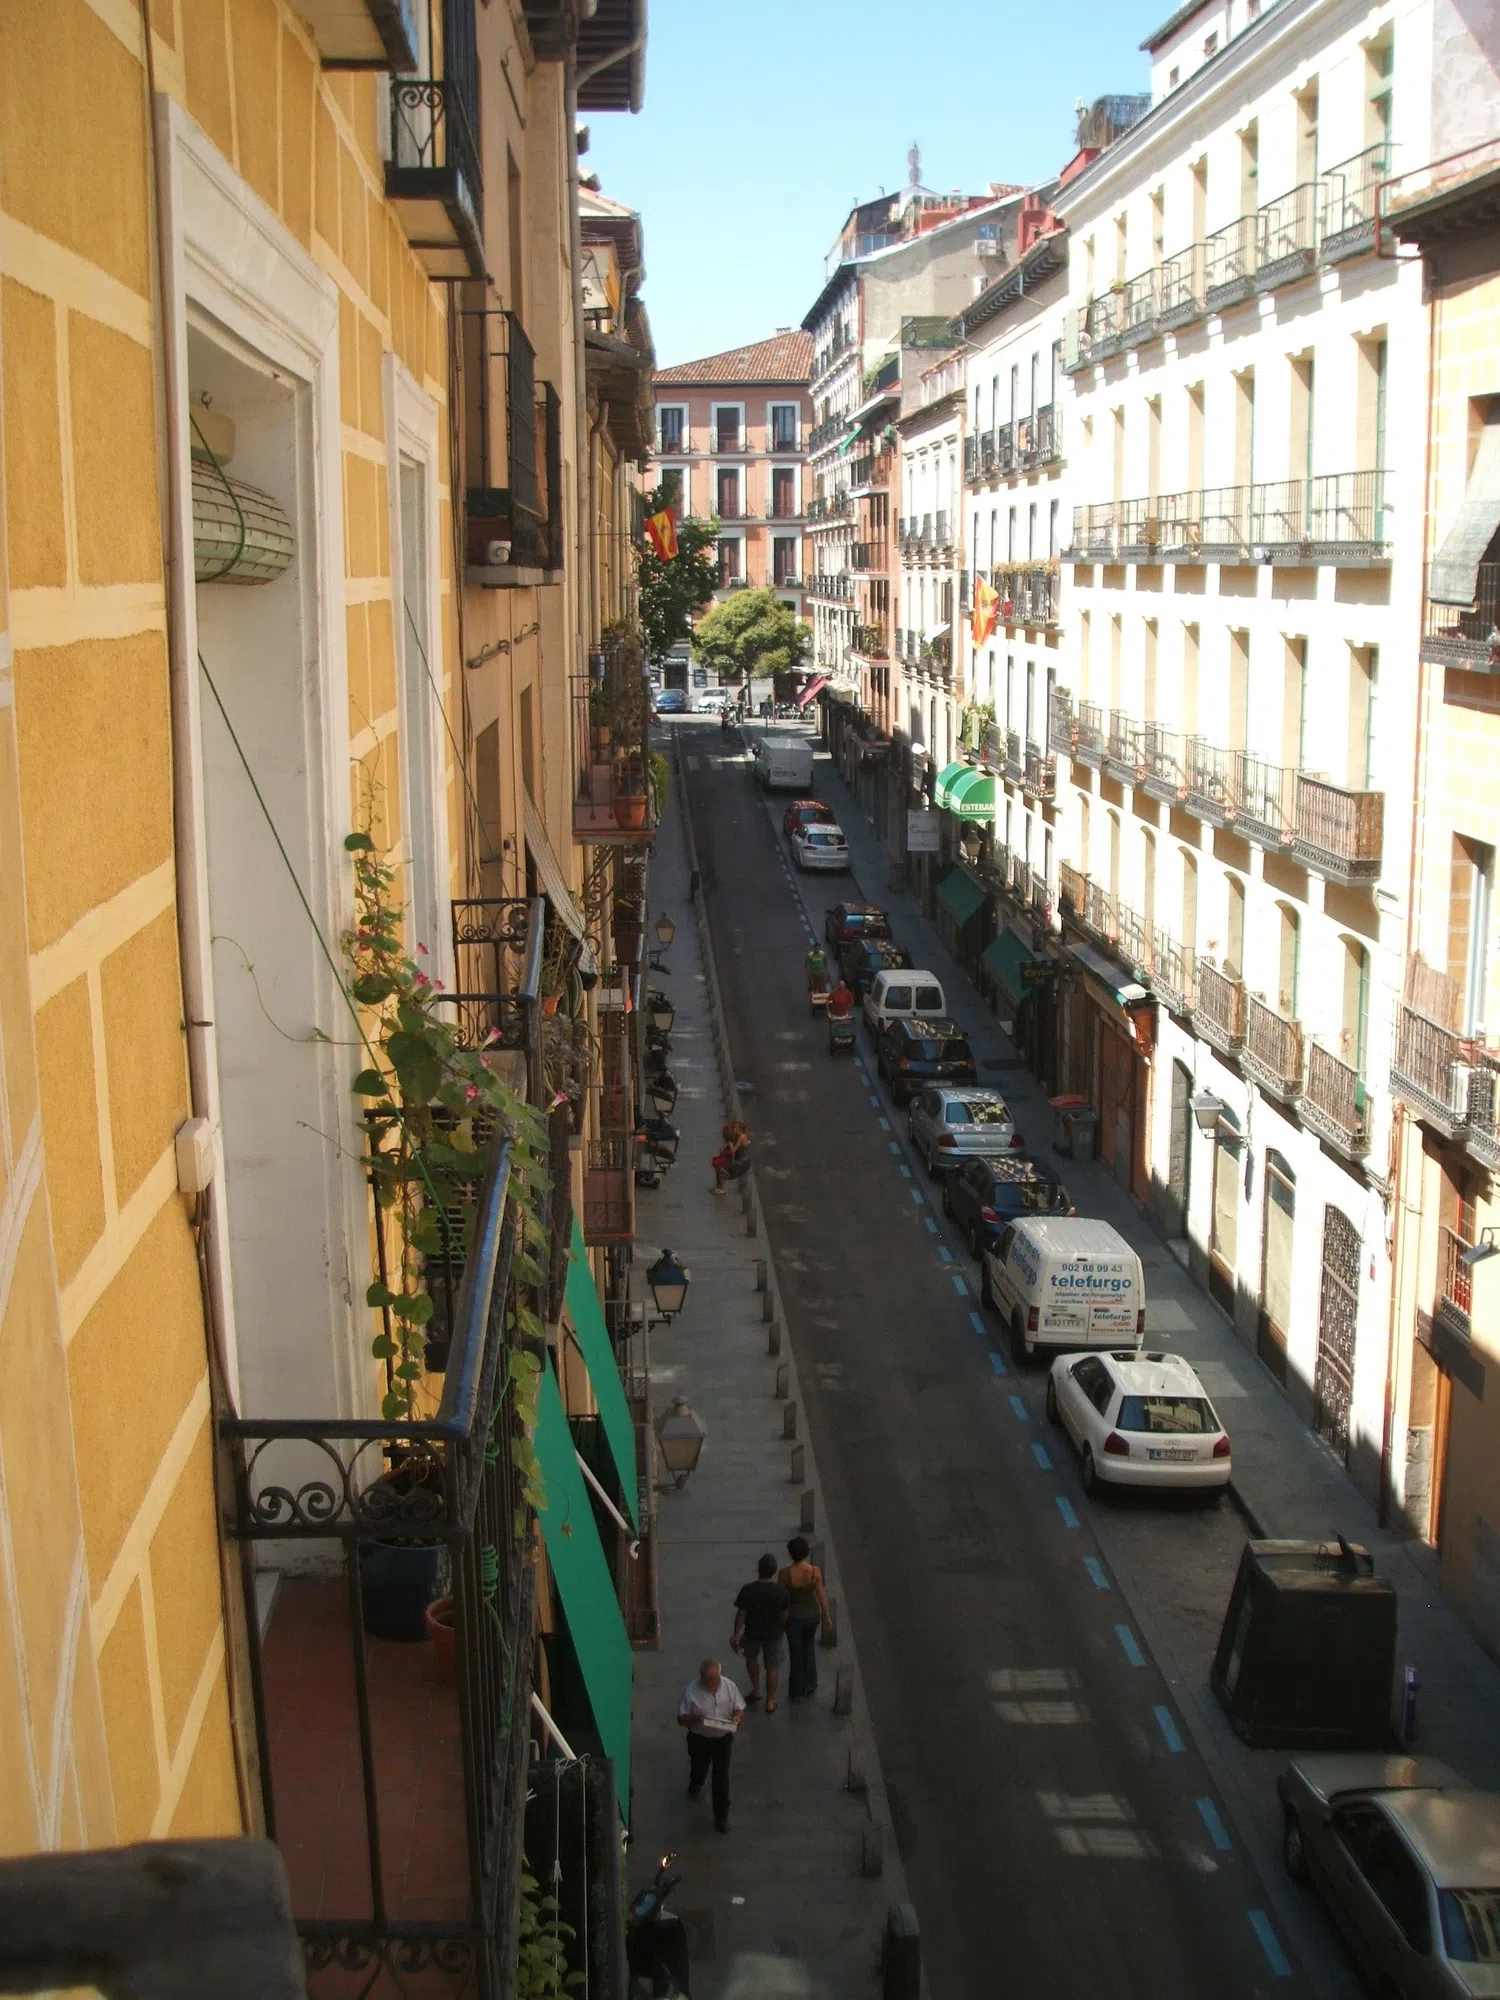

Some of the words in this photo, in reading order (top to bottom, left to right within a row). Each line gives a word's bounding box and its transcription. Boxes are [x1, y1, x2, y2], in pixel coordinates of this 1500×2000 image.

[961, 803, 995, 812] ESTEBAN
[1062, 1263, 1080, 1272] 902
[1082, 1264, 1095, 1272] 88
[1097, 1264, 1109, 1272] 99
[1051, 1275, 1132, 1291] telefurgo
[1094, 1313, 1132, 1321] telefurgo
